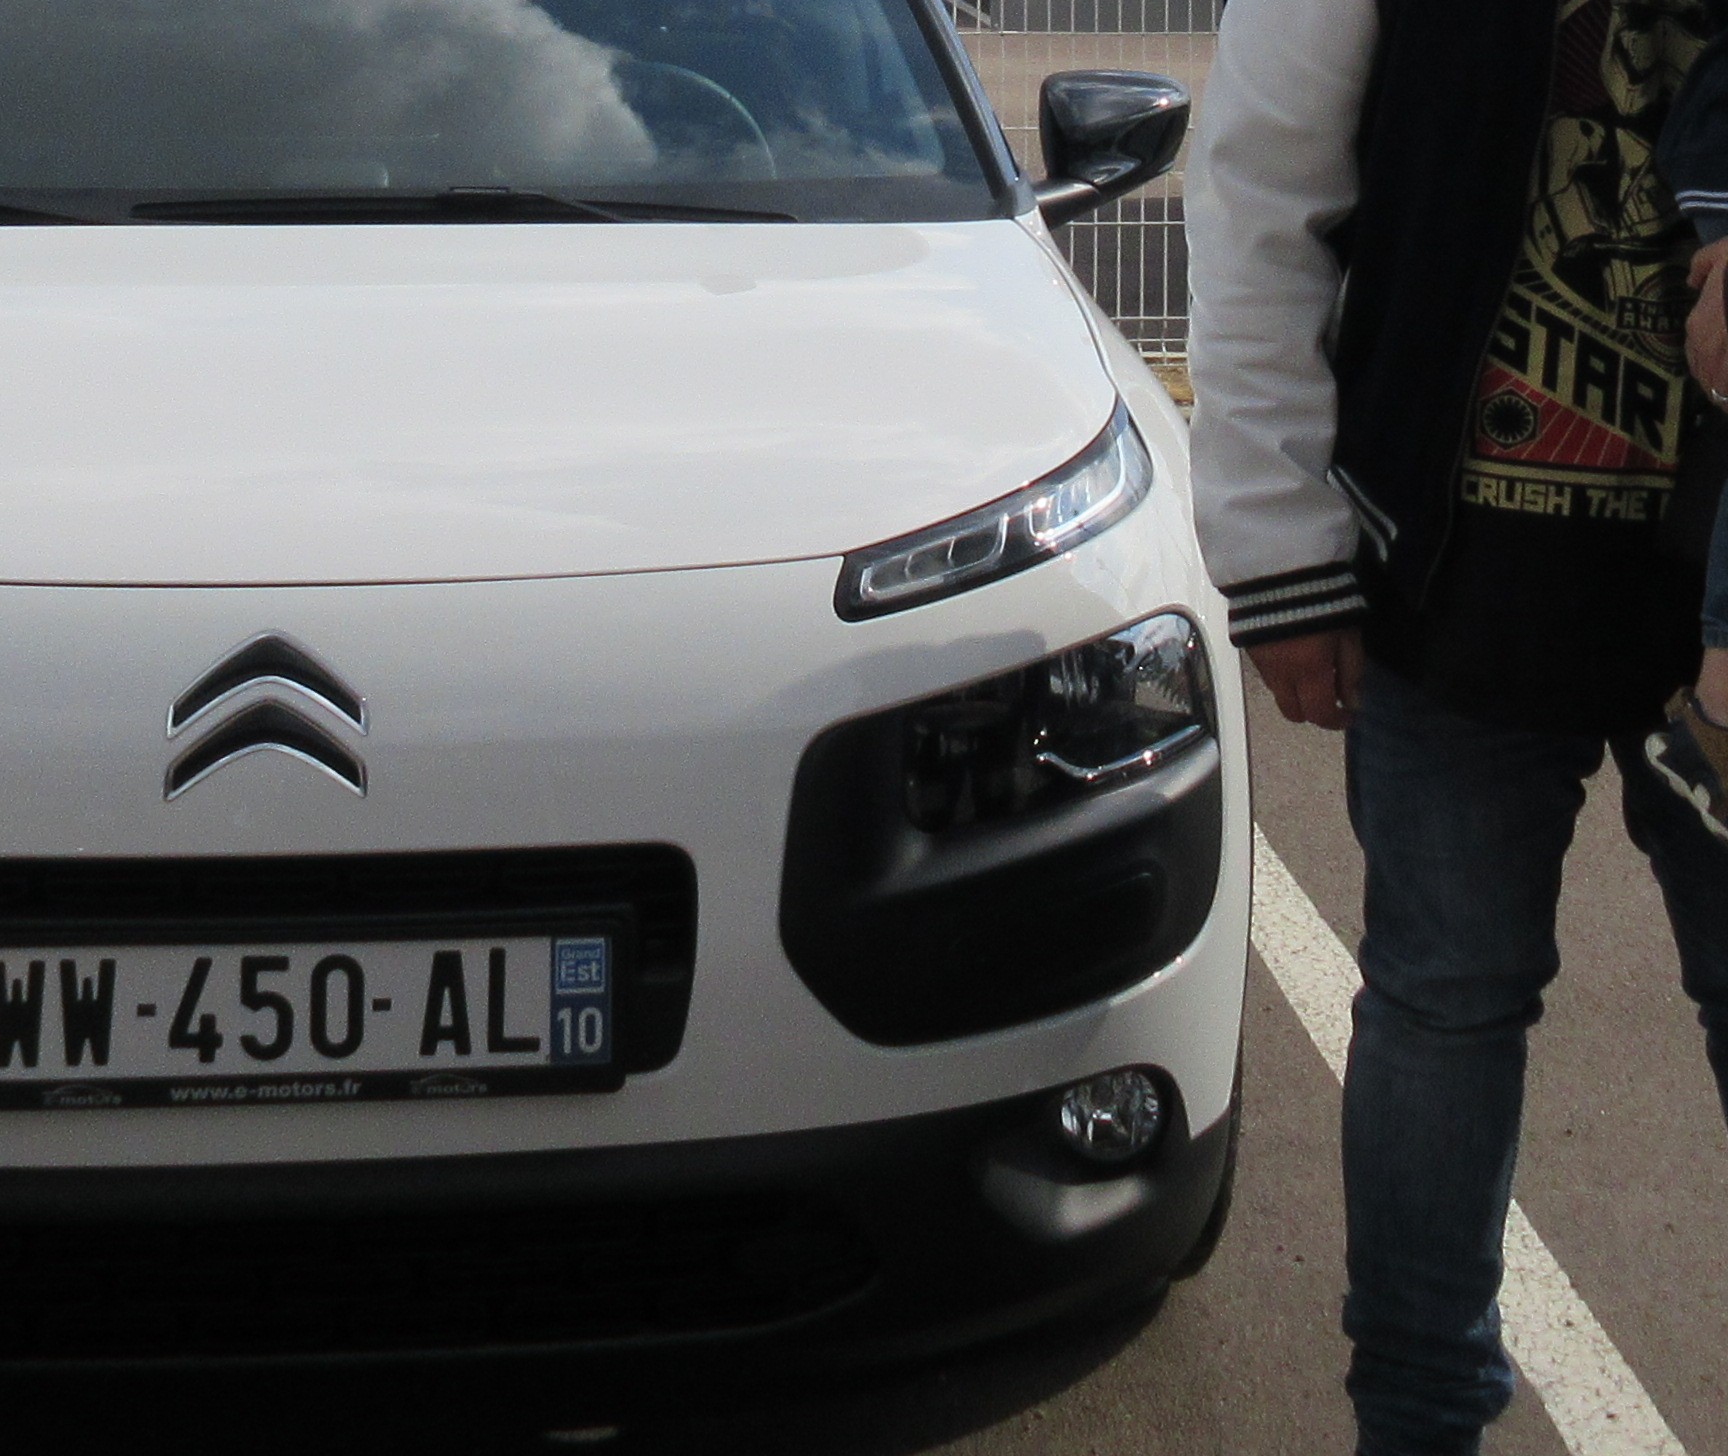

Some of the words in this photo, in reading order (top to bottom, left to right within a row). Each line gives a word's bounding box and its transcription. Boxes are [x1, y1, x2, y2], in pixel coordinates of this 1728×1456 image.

[1488, 292, 1669, 455] STAR
[1461, 473, 1572, 517] CRUSH
[1585, 487, 1649, 522] THE
[560, 947, 602, 961] Grand
[560, 960, 601, 984] Est
[557, 1005, 604, 1055] 10
[170, 1078, 363, 1103] www.e-motors.fr
